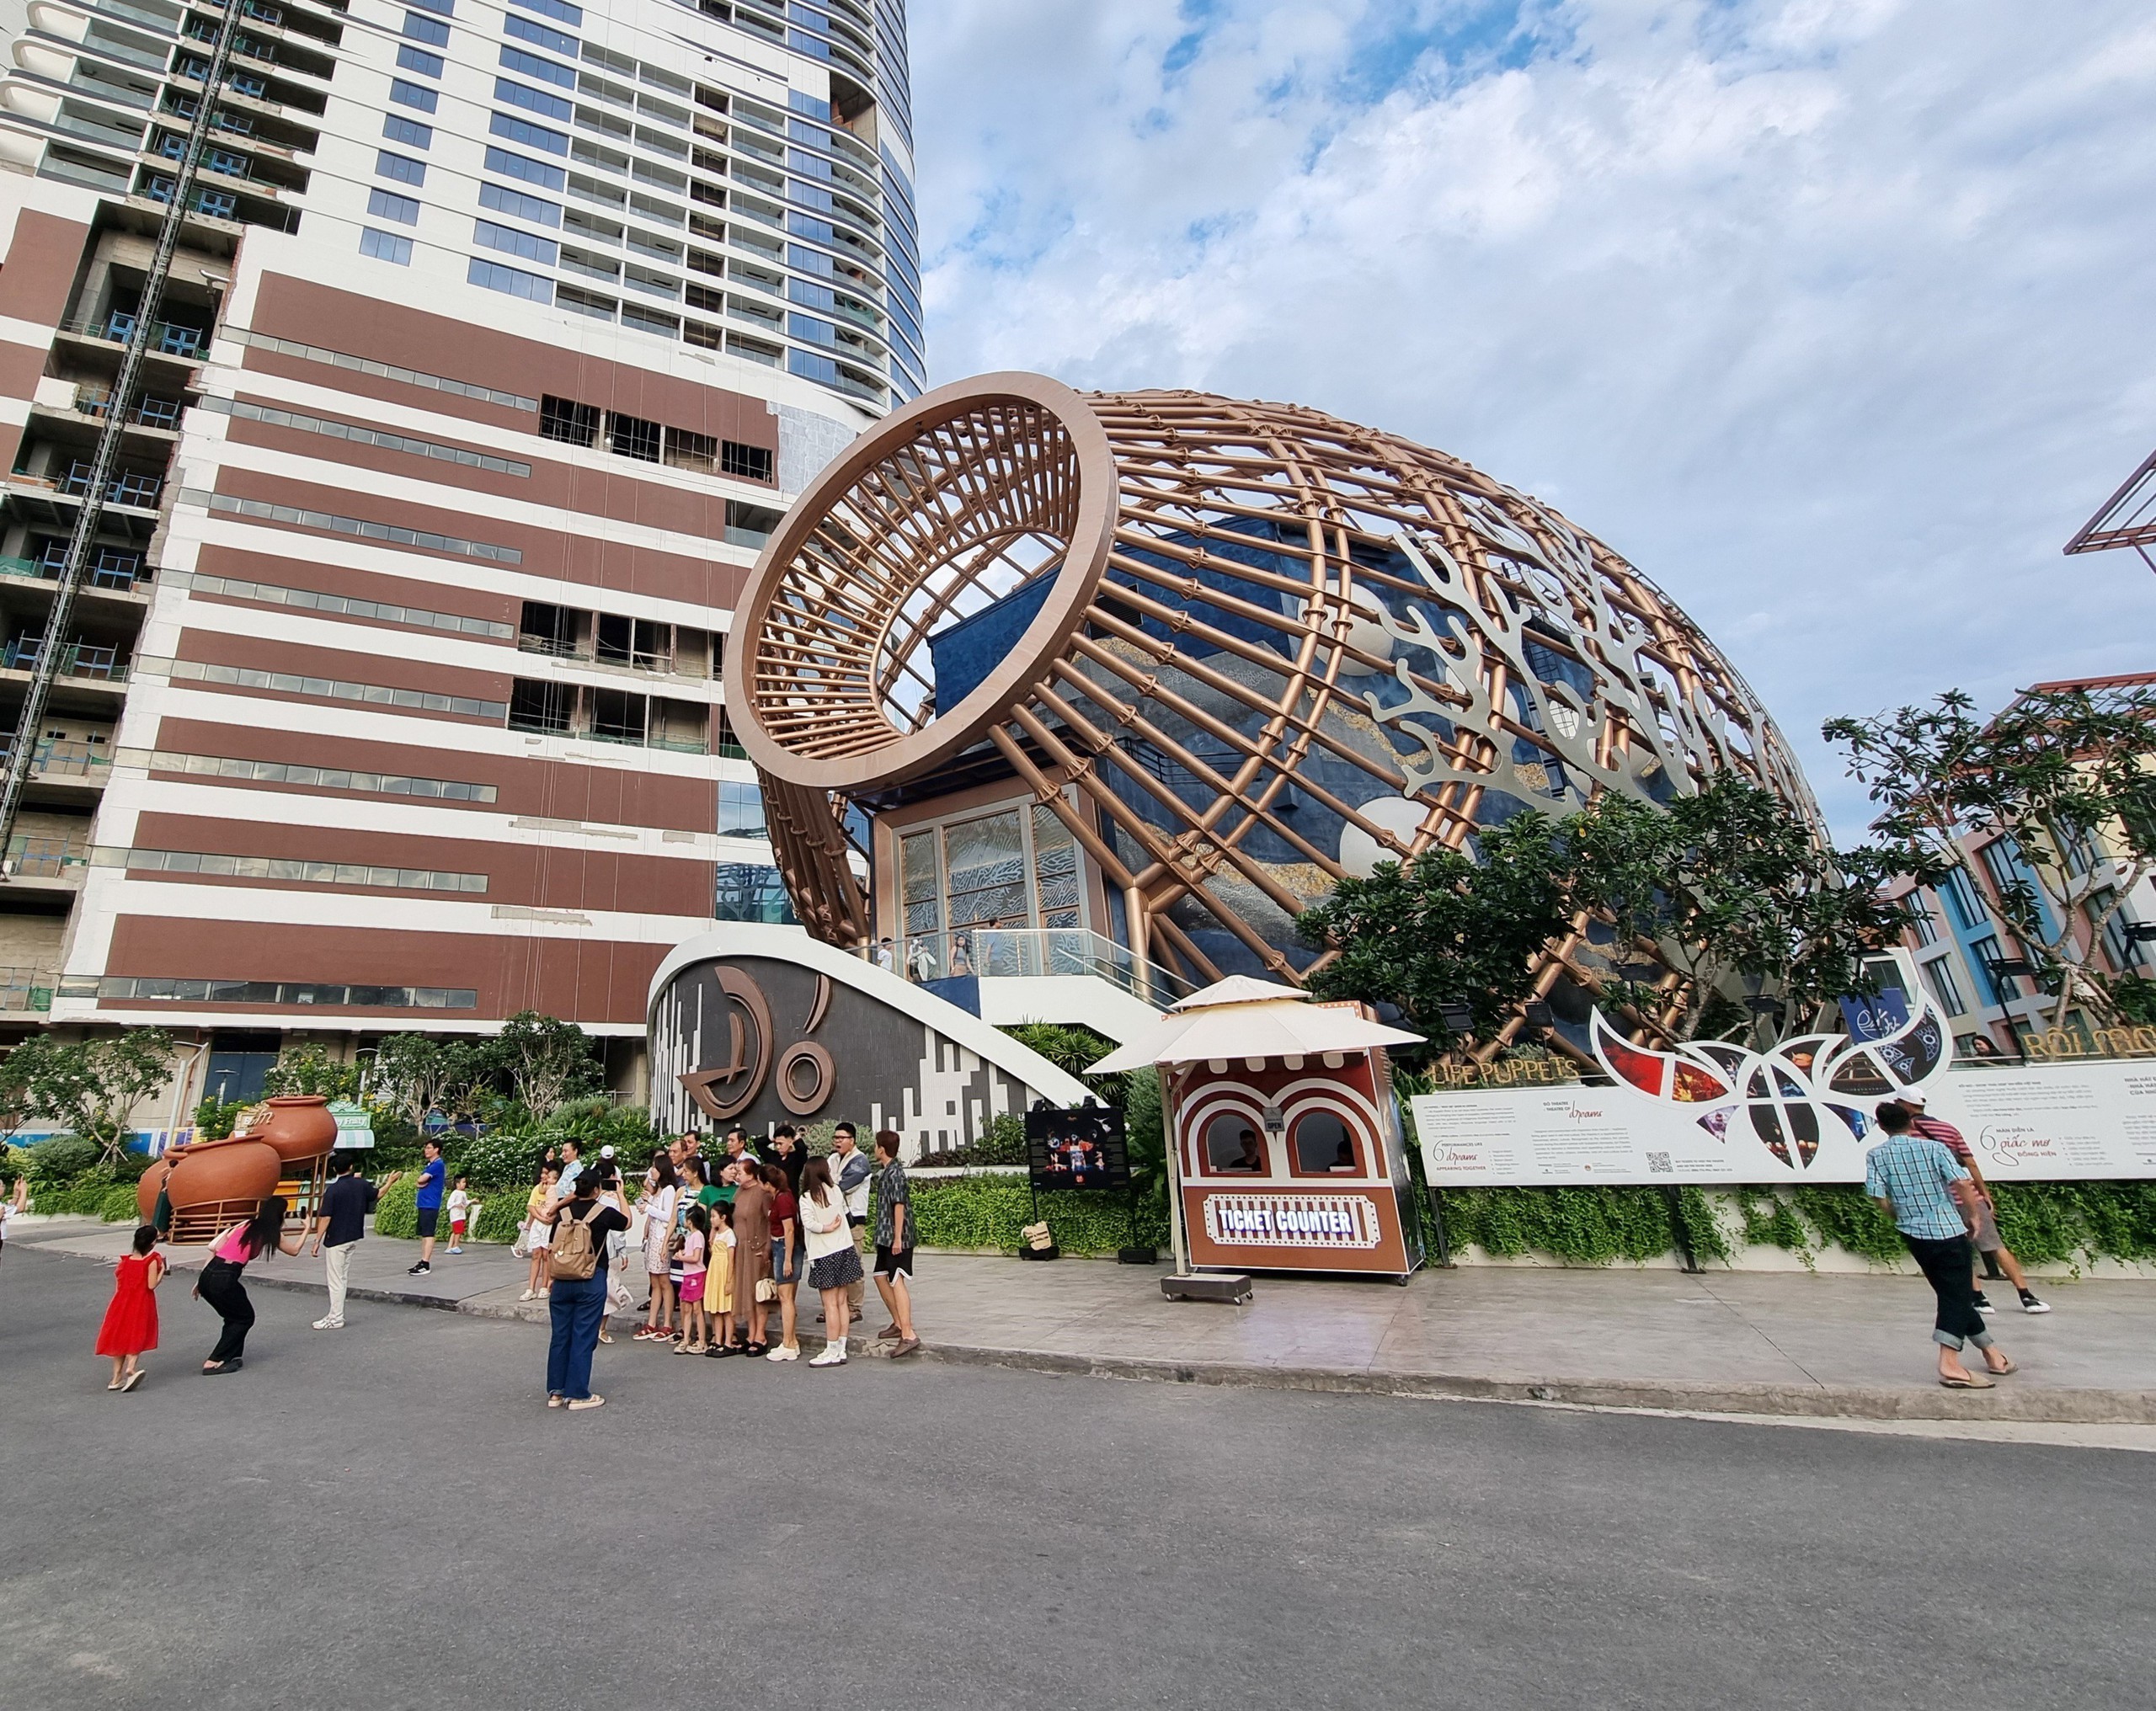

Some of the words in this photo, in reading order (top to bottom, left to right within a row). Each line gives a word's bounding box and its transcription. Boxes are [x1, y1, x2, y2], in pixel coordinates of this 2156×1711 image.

[1432, 1063, 1477, 1085] LIFE
[1478, 1056, 1581, 1084] PUPPETS
[1980, 1124, 1996, 1150] 6
[1433, 1139, 1444, 1162] 6
[1219, 1209, 1272, 1232] TICKET
[1275, 1210, 1353, 1234] COUNTER
